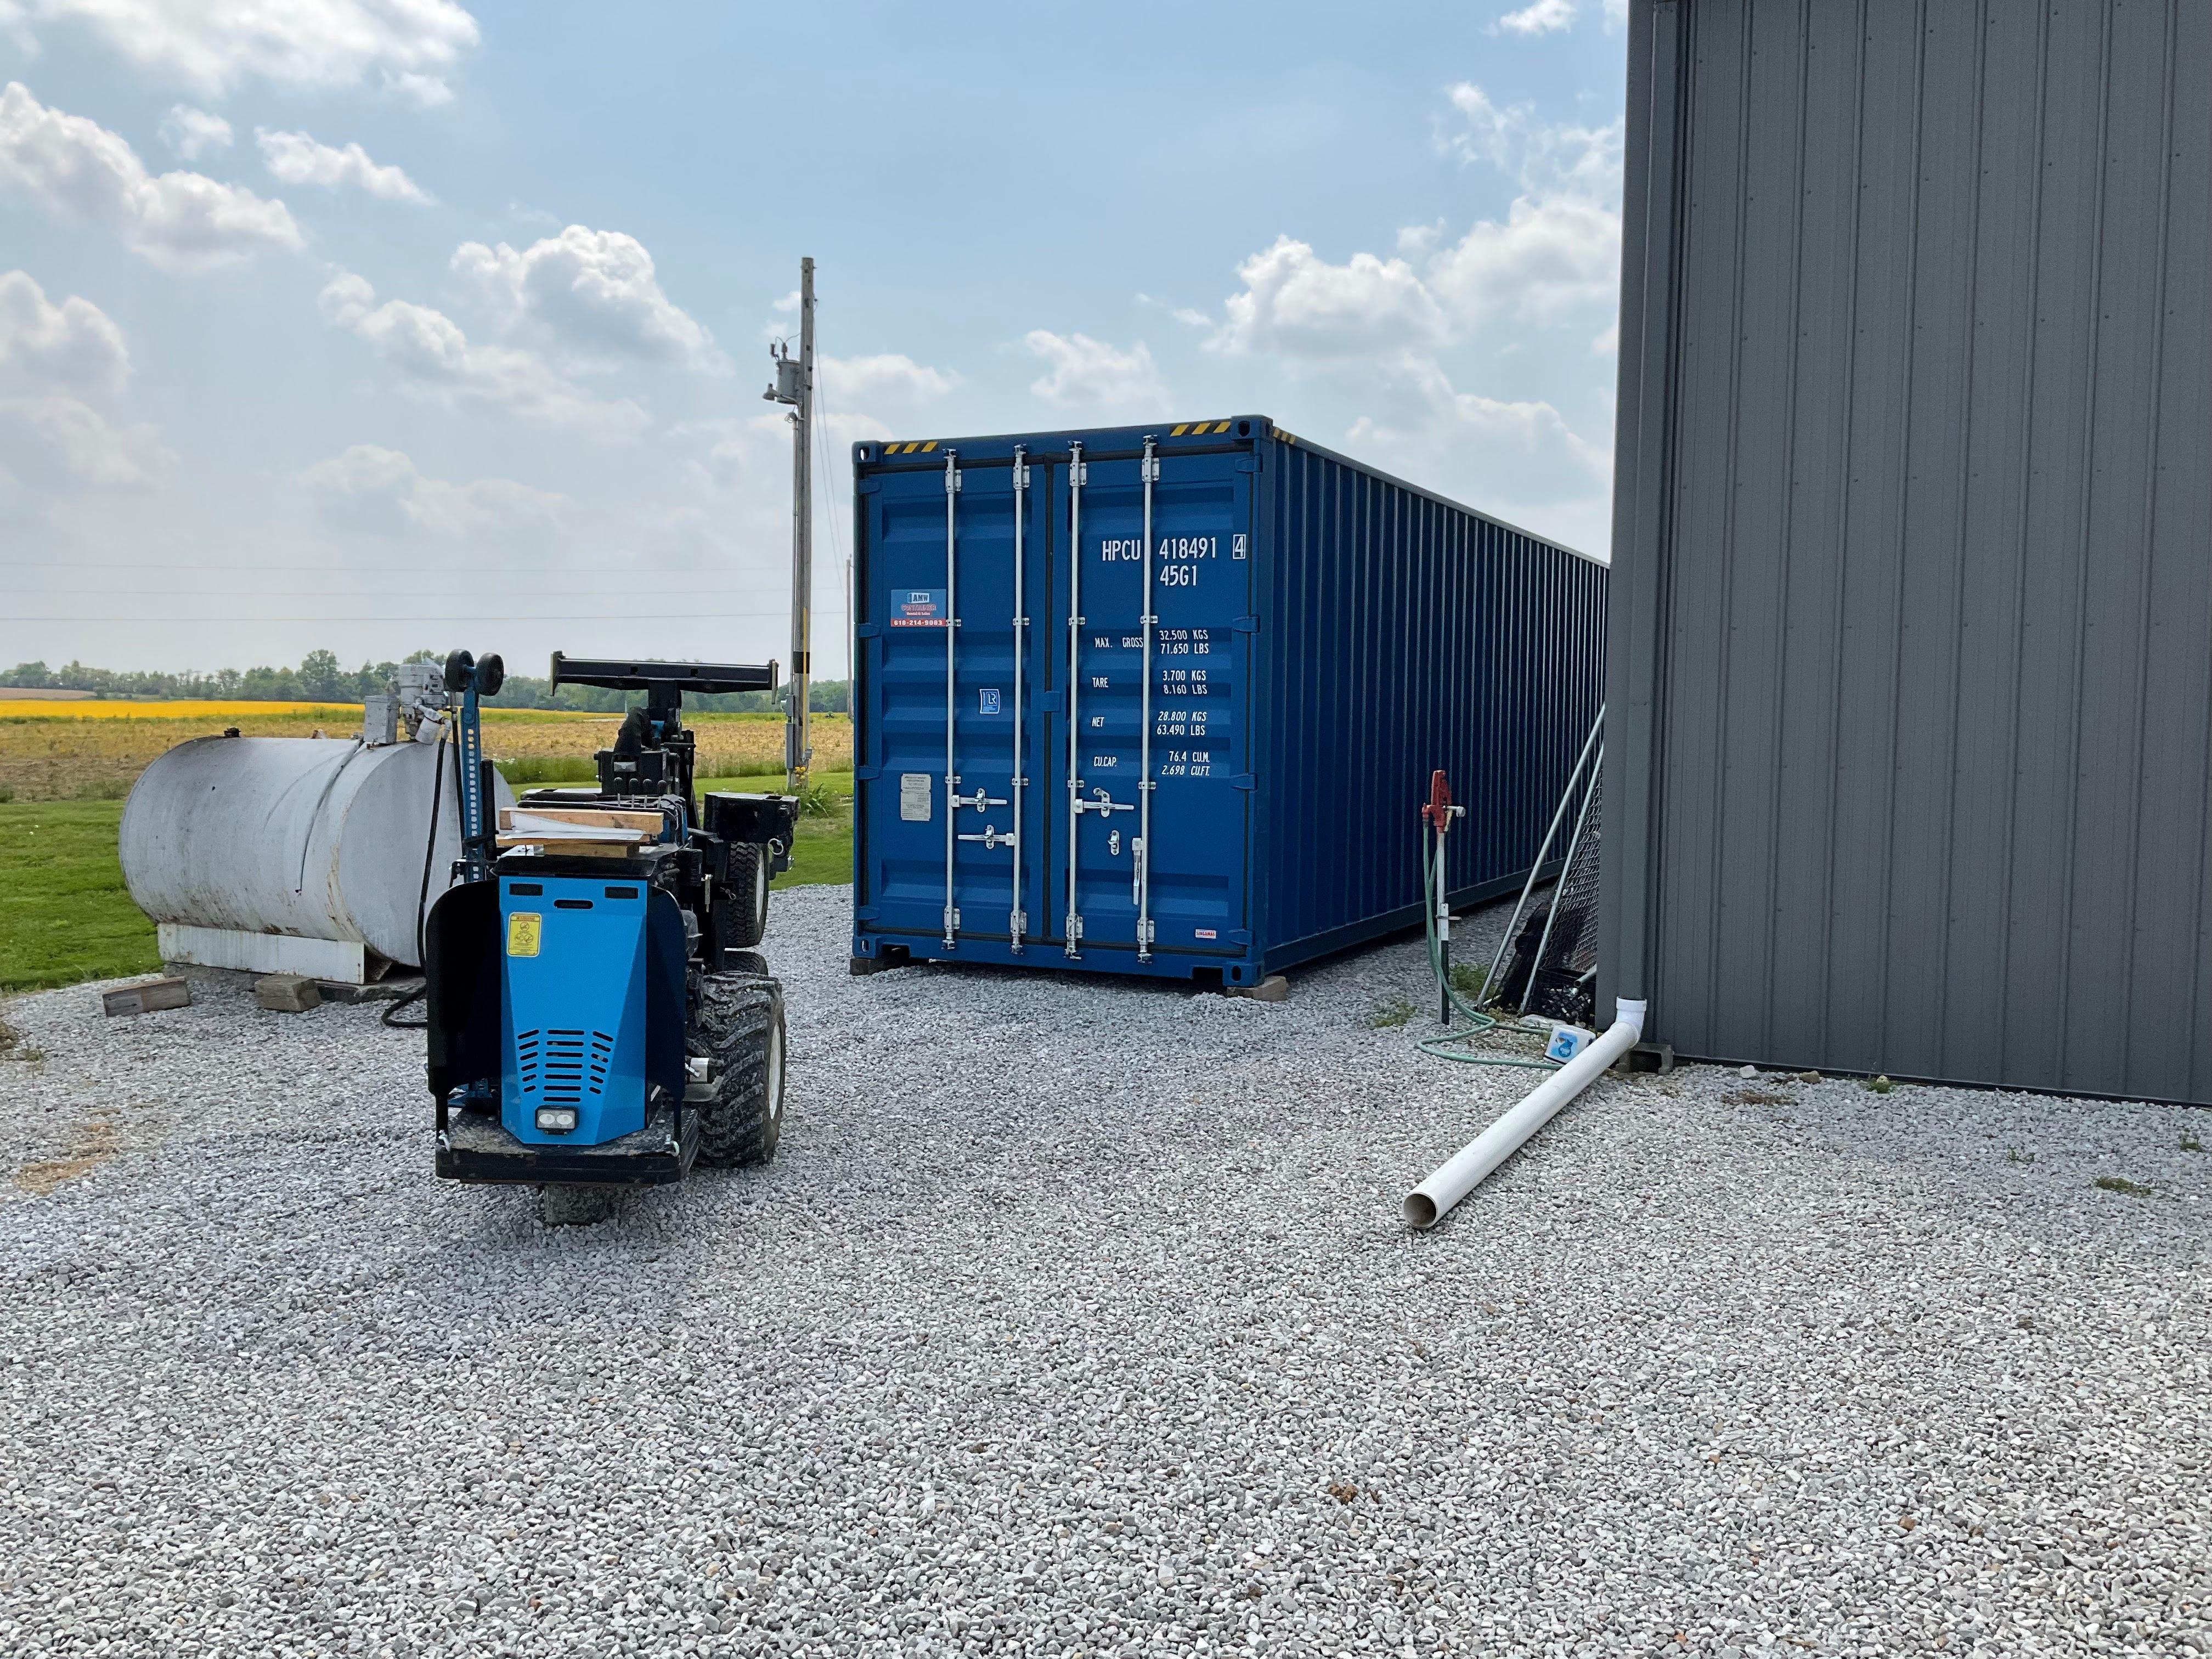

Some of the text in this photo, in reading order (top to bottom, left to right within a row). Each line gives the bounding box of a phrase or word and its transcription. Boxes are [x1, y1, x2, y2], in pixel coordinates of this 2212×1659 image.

[1102, 535, 1245, 561] HPCU 418491 4
[1159, 565, 1197, 586] 45G1
[1159, 629, 1209, 640] 32.500 KGS
[1094, 637, 1143, 648] MAX. GROSS
[1160, 643, 1209, 654] 71.650 LBS
[1163, 670, 1206, 681] 3.700 KGS
[1092, 677, 1109, 688] TARE
[1164, 684, 1207, 695] 8.160 LBS
[1092, 716, 1104, 727] NET
[1158, 711, 1207, 722] 28.800 KGS
[1156, 724, 1205, 736] 63.490 LBS
[1093, 756, 1117, 767] CU.CAP.
[1169, 751, 1210, 763] 76.4 CU.M.
[1161, 765, 1210, 776] 2.698 CU.FT.
